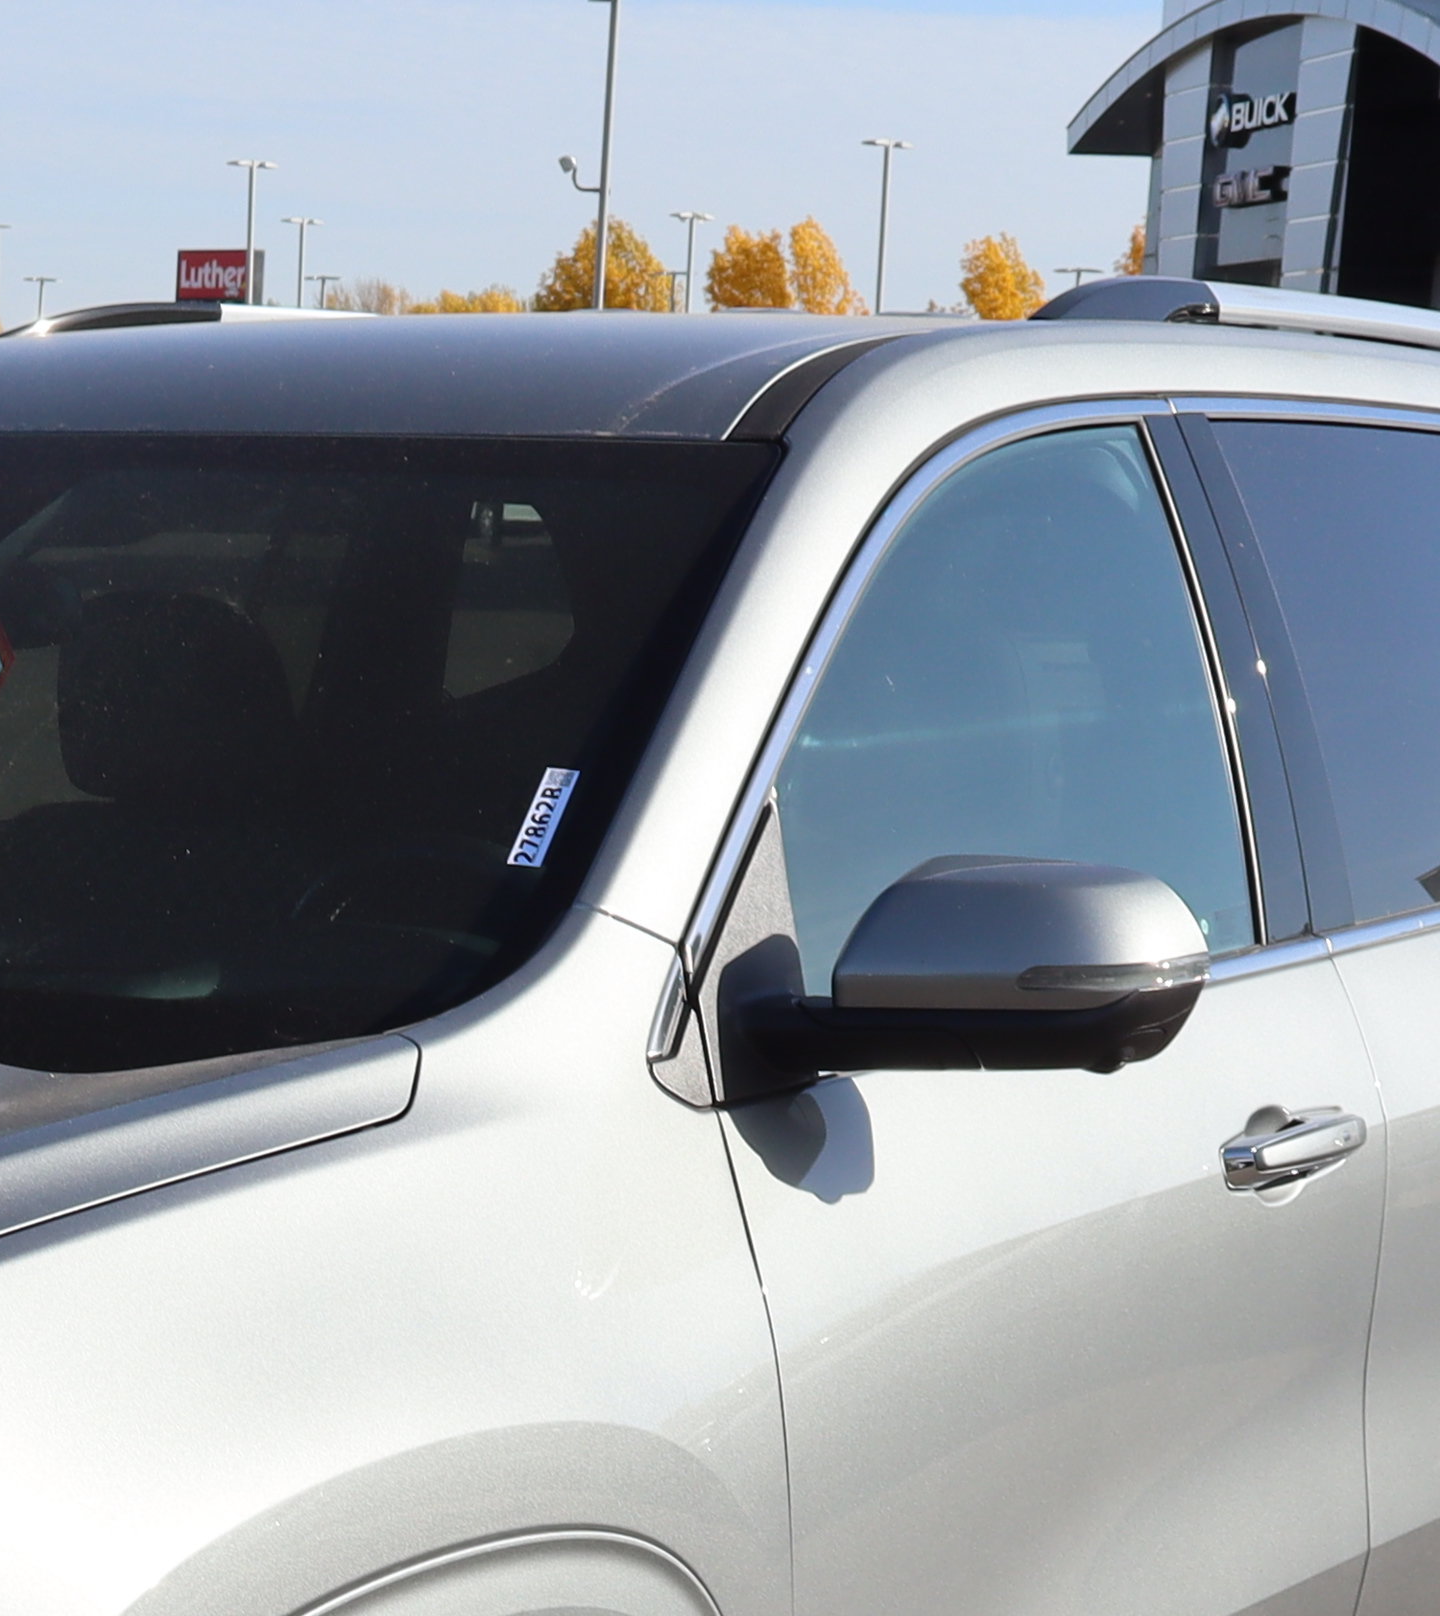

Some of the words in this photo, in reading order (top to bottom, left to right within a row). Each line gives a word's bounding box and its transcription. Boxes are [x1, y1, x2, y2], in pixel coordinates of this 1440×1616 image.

[1230, 91, 1292, 132] BUICK
[1213, 165, 1275, 208] GMC
[180, 259, 245, 289] Luther
[513, 786, 563, 864] 27862B
